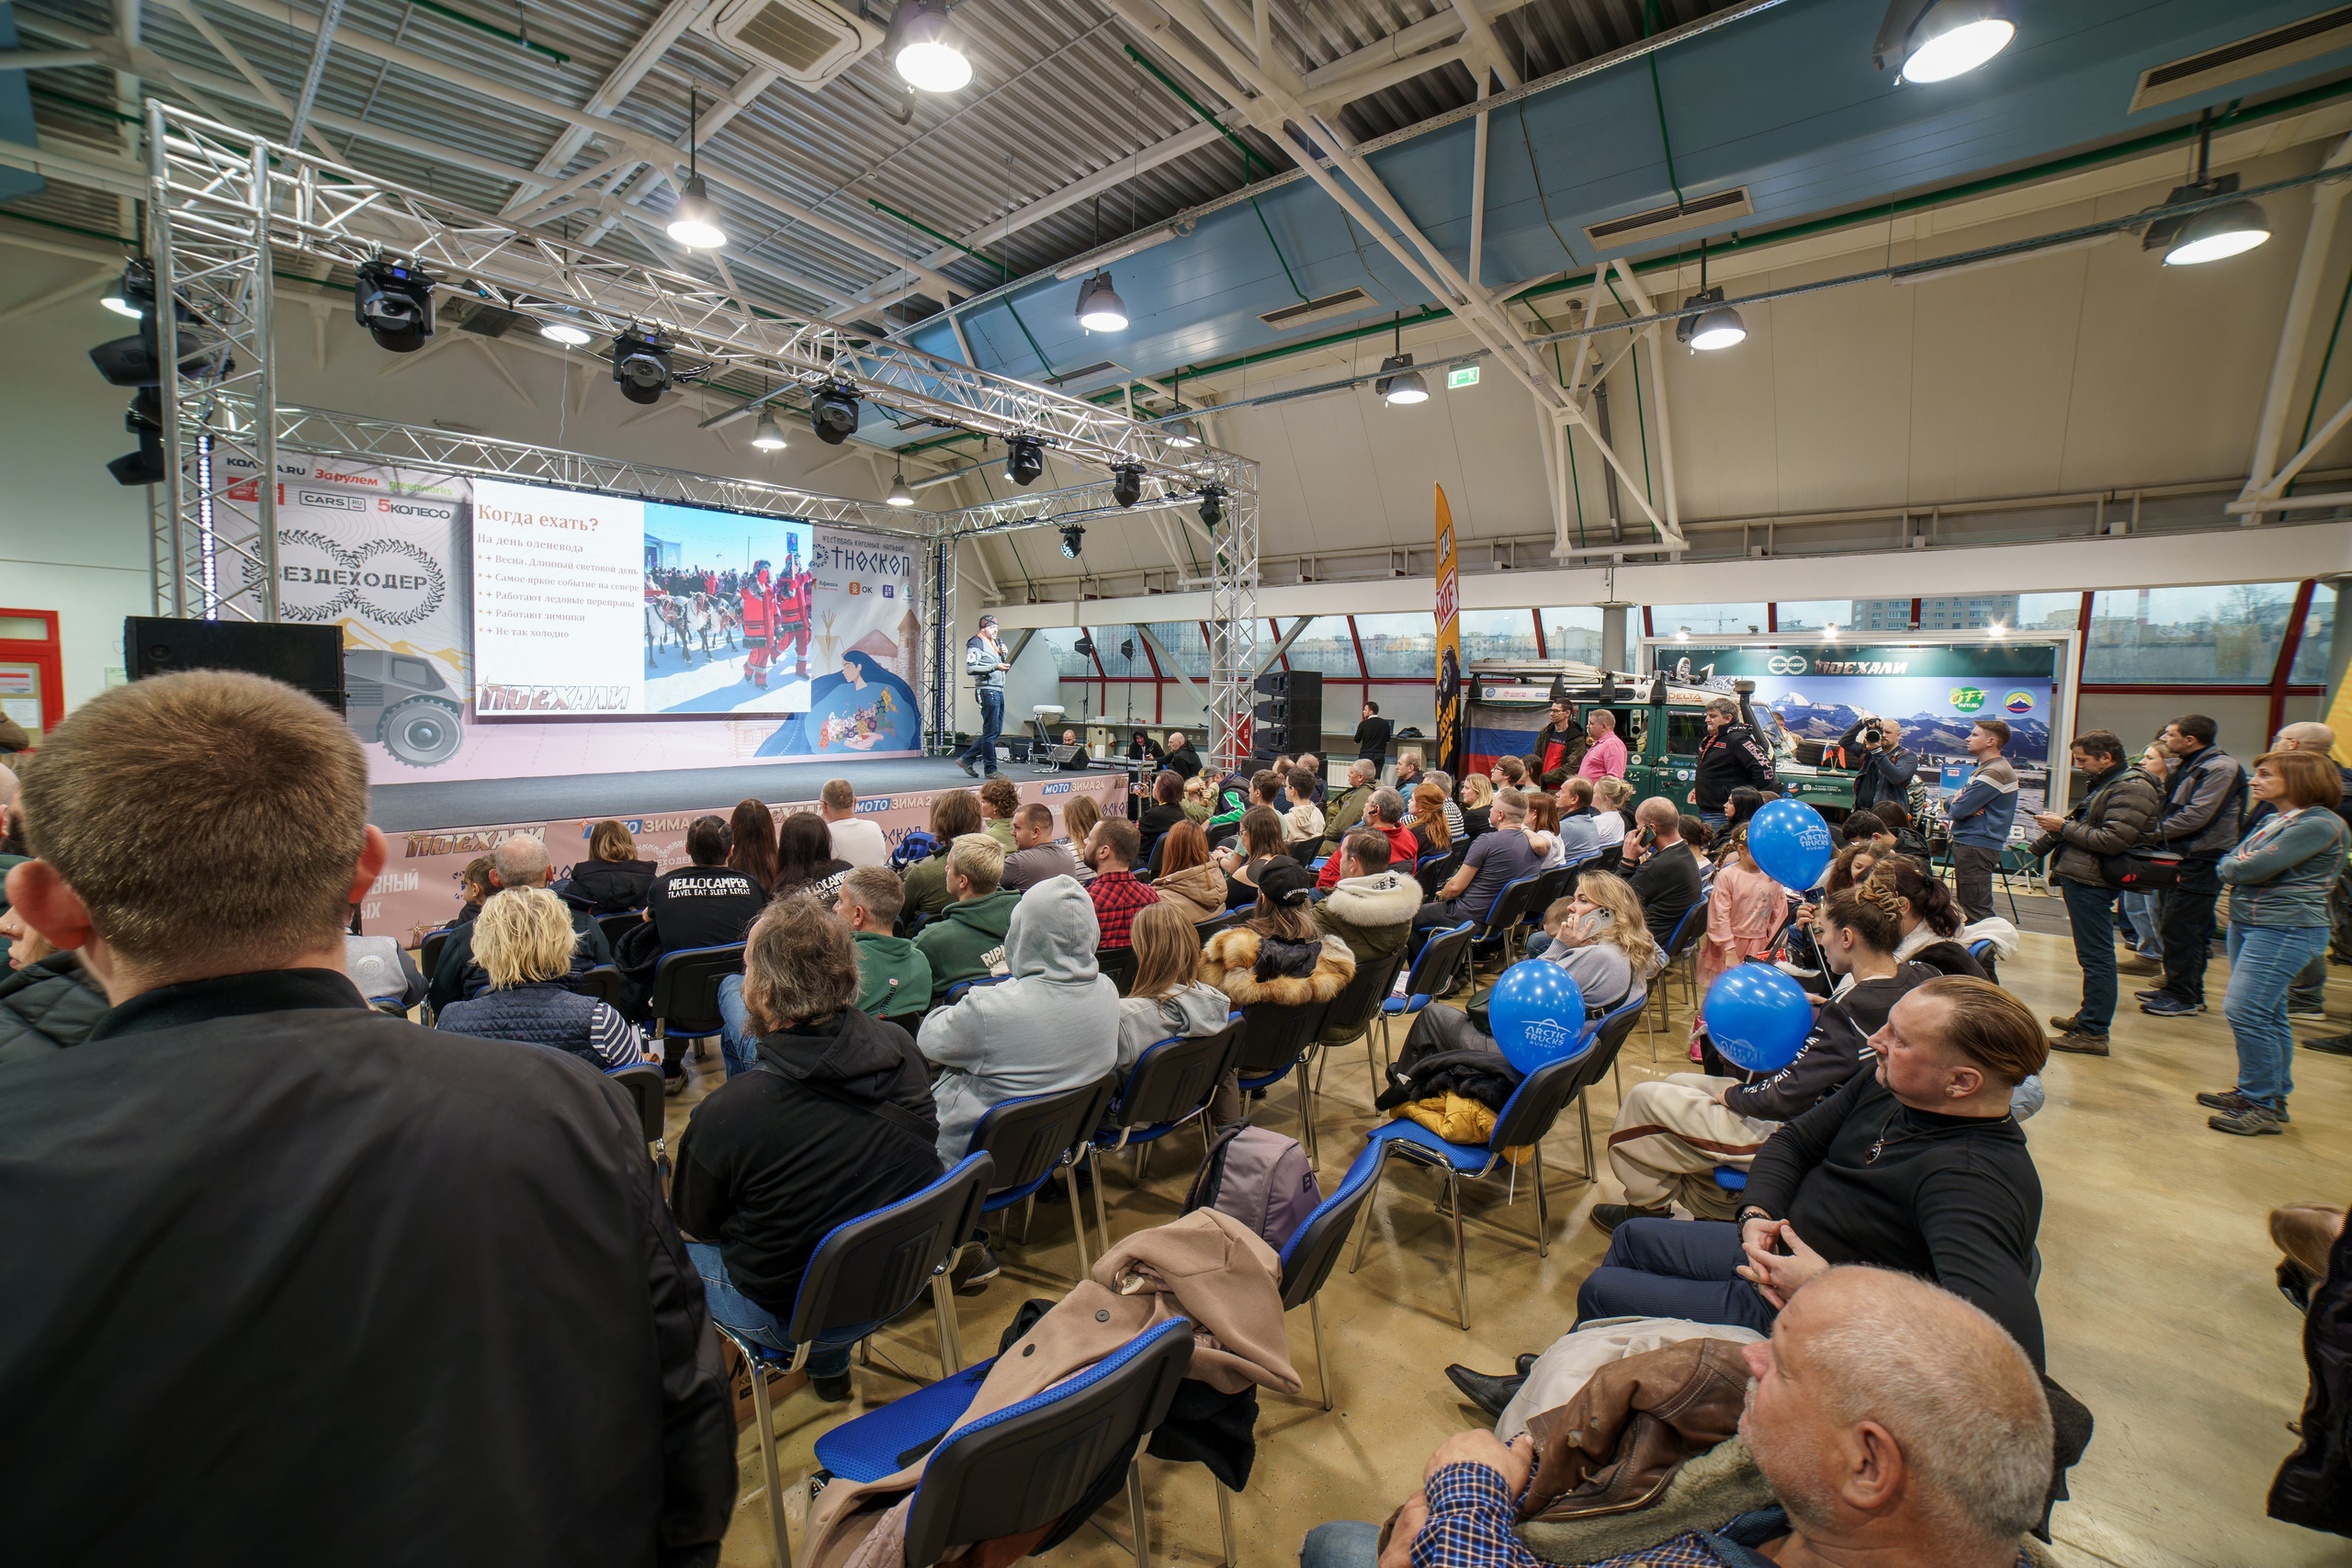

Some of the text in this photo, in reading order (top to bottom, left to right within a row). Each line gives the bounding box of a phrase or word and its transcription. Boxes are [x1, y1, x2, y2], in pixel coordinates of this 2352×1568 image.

[389, 479, 452, 496] greenworks
[305, 494, 345, 506] CARS
[378, 499, 450, 519] 5КОЛЕСО
[478, 504, 599, 532] Когда ехать?
[478, 533, 583, 553] На день оленевода
[495, 555, 527, 566] Весна.
[529, 558, 573, 570] Длинный
[576, 563, 616, 573] световой
[617, 566, 639, 575] день
[279, 566, 427, 590] ЕЗДЕХОДЕР
[495, 573, 526, 583] Самое
[527, 577, 555, 586] яркое
[558, 579, 595, 589] событие
[610, 583, 639, 593] севере
[496, 592, 542, 603] Работают
[544, 594, 584, 604] ледовые
[586, 598, 634, 608] переправы
[1440, 579, 1453, 626] RIF
[496, 609, 542, 619] Работают
[544, 612, 585, 622] зимники
[496, 626, 509, 636] Не
[531, 629, 570, 638] холодно
[1814, 661, 1909, 674] ПОЕХАЛИ
[478, 685, 630, 710] ПОЕХАЛИ
[1045, 783, 1069, 794] МОТО
[1071, 782, 1094, 791] ЗИМА
[1095, 781, 1104, 790] 24
[854, 799, 888, 812] МОТО
[891, 797, 924, 809] ЗИМА
[643, 818, 689, 832] ЗИМА
[669, 878, 749, 891] HELLOCAMPER
[667, 889, 691, 898] TRAVEL
[1525, 1025, 1566, 1040] ARCTIC
[1525, 1032, 1566, 1045] TRUCKS
[1529, 1040, 1555, 1049] RUSSIA
